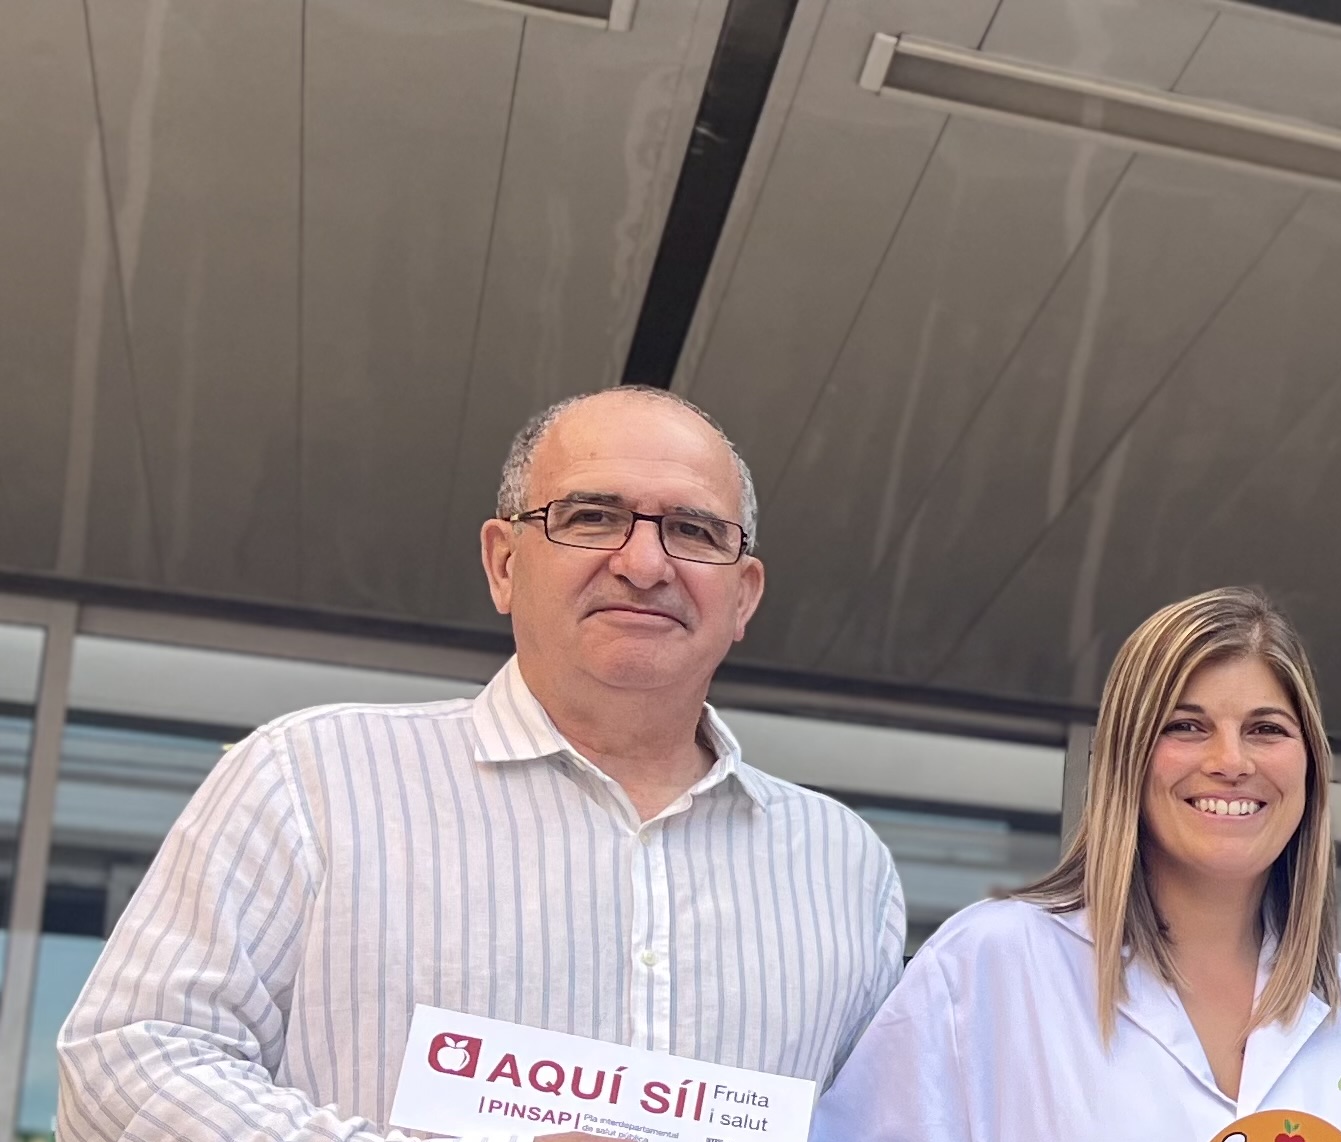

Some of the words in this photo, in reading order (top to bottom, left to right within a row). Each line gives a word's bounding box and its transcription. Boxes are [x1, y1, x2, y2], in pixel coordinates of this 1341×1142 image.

[487, 1053, 625, 1104] AQUÍ
[640, 1079, 692, 1118] SÍ
[713, 1084, 769, 1108] Fruita
[488, 1099, 572, 1125] PINSAP
[708, 1109, 714, 1123] i
[719, 1113, 768, 1132] salut
[581, 1124, 594, 1132] de
